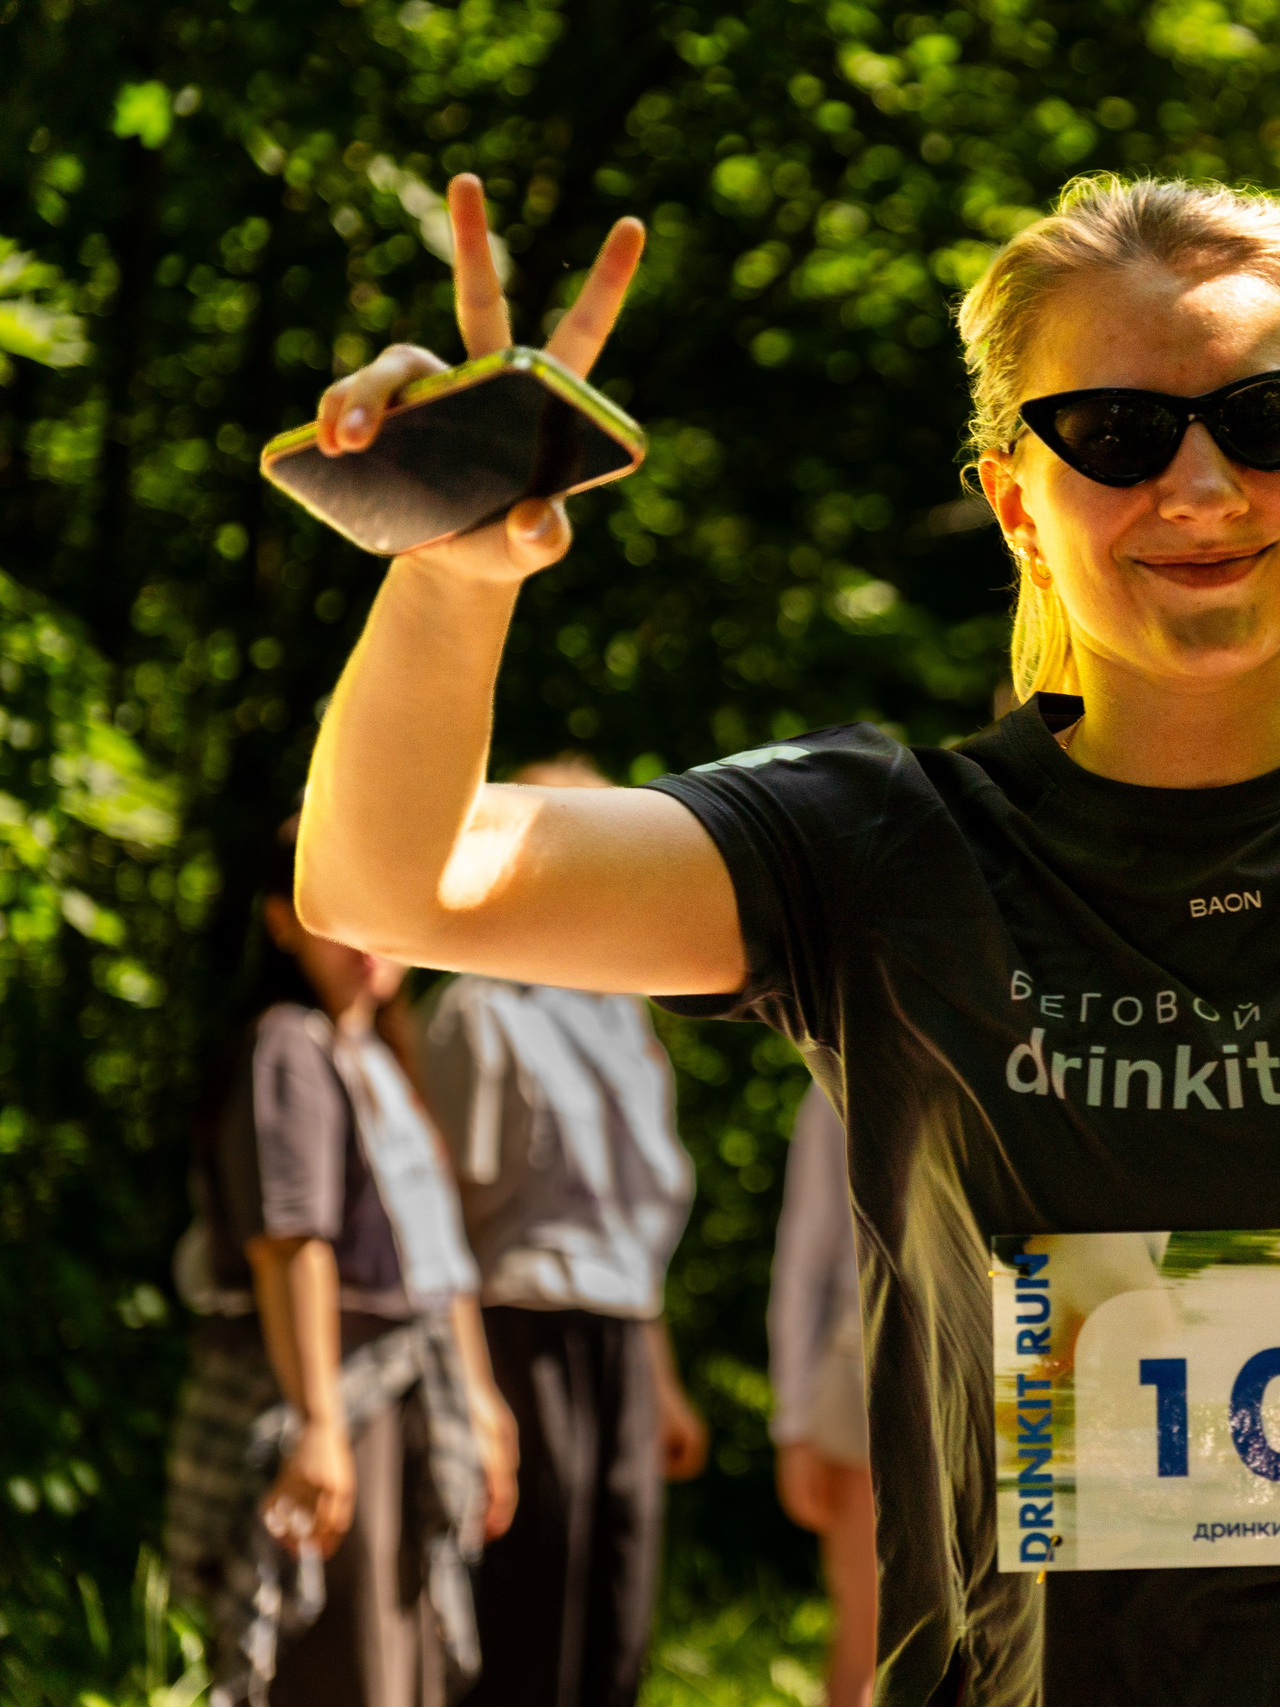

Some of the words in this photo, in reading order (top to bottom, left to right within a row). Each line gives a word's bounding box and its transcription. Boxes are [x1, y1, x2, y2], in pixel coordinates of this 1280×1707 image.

[1190, 890, 1262, 918] BAON
[1010, 970, 1261, 1031] БЕГОВОЙ
[1014, 1254, 1051, 1355] RUN
[1016, 1373, 1054, 1563] DRINKIT
